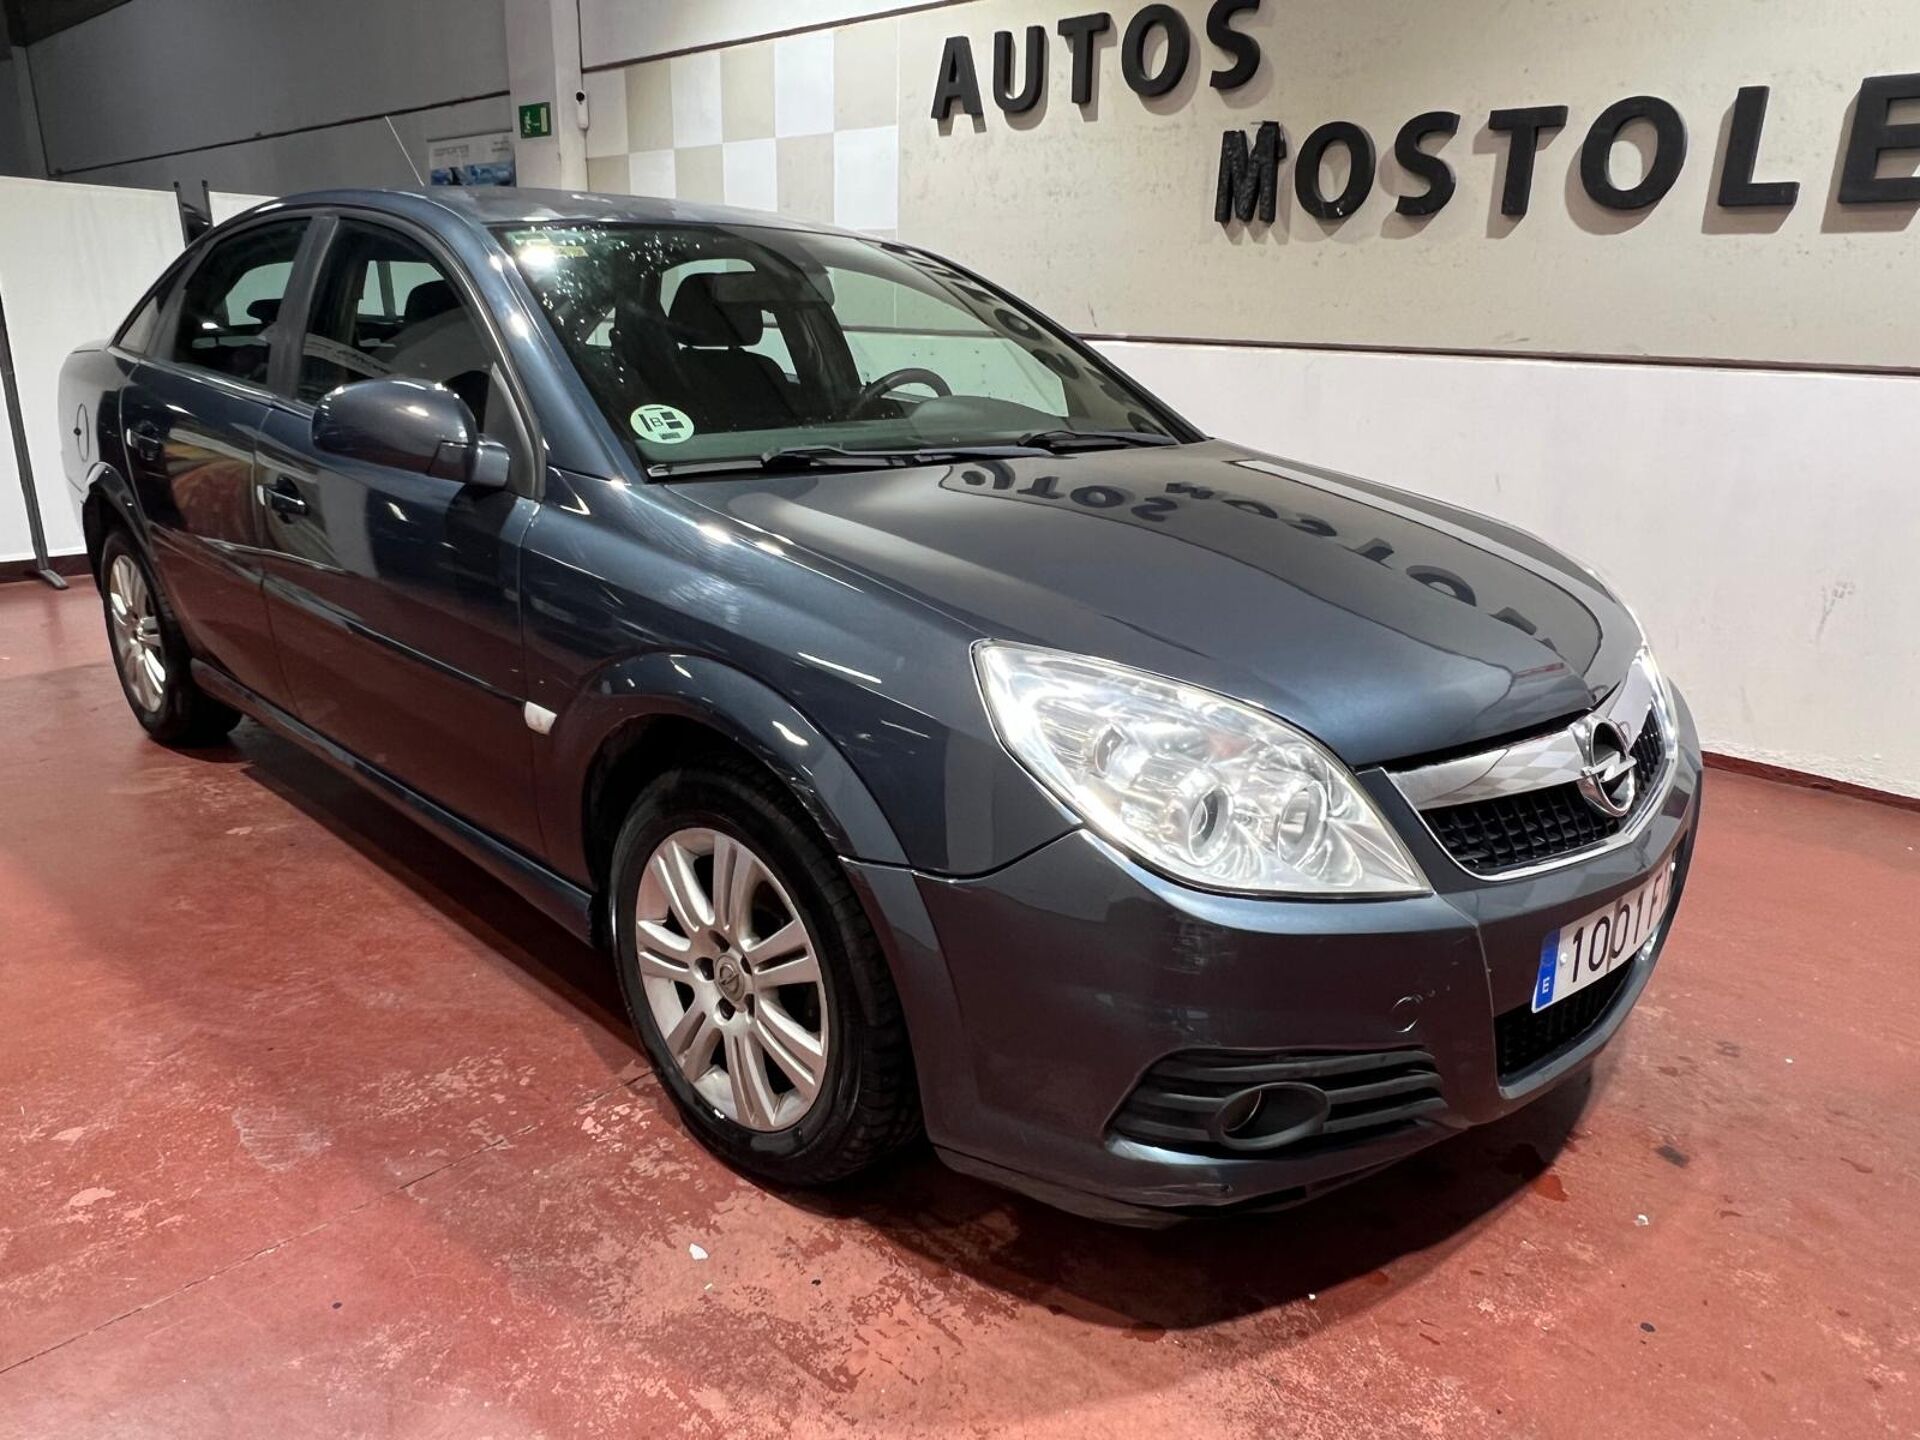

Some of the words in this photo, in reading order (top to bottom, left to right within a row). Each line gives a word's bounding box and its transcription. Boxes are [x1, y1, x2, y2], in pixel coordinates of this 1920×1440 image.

[931, 0, 1261, 119] AUTOS
[1214, 72, 1920, 223] MOSTOLE
[1542, 976, 1550, 994] E
